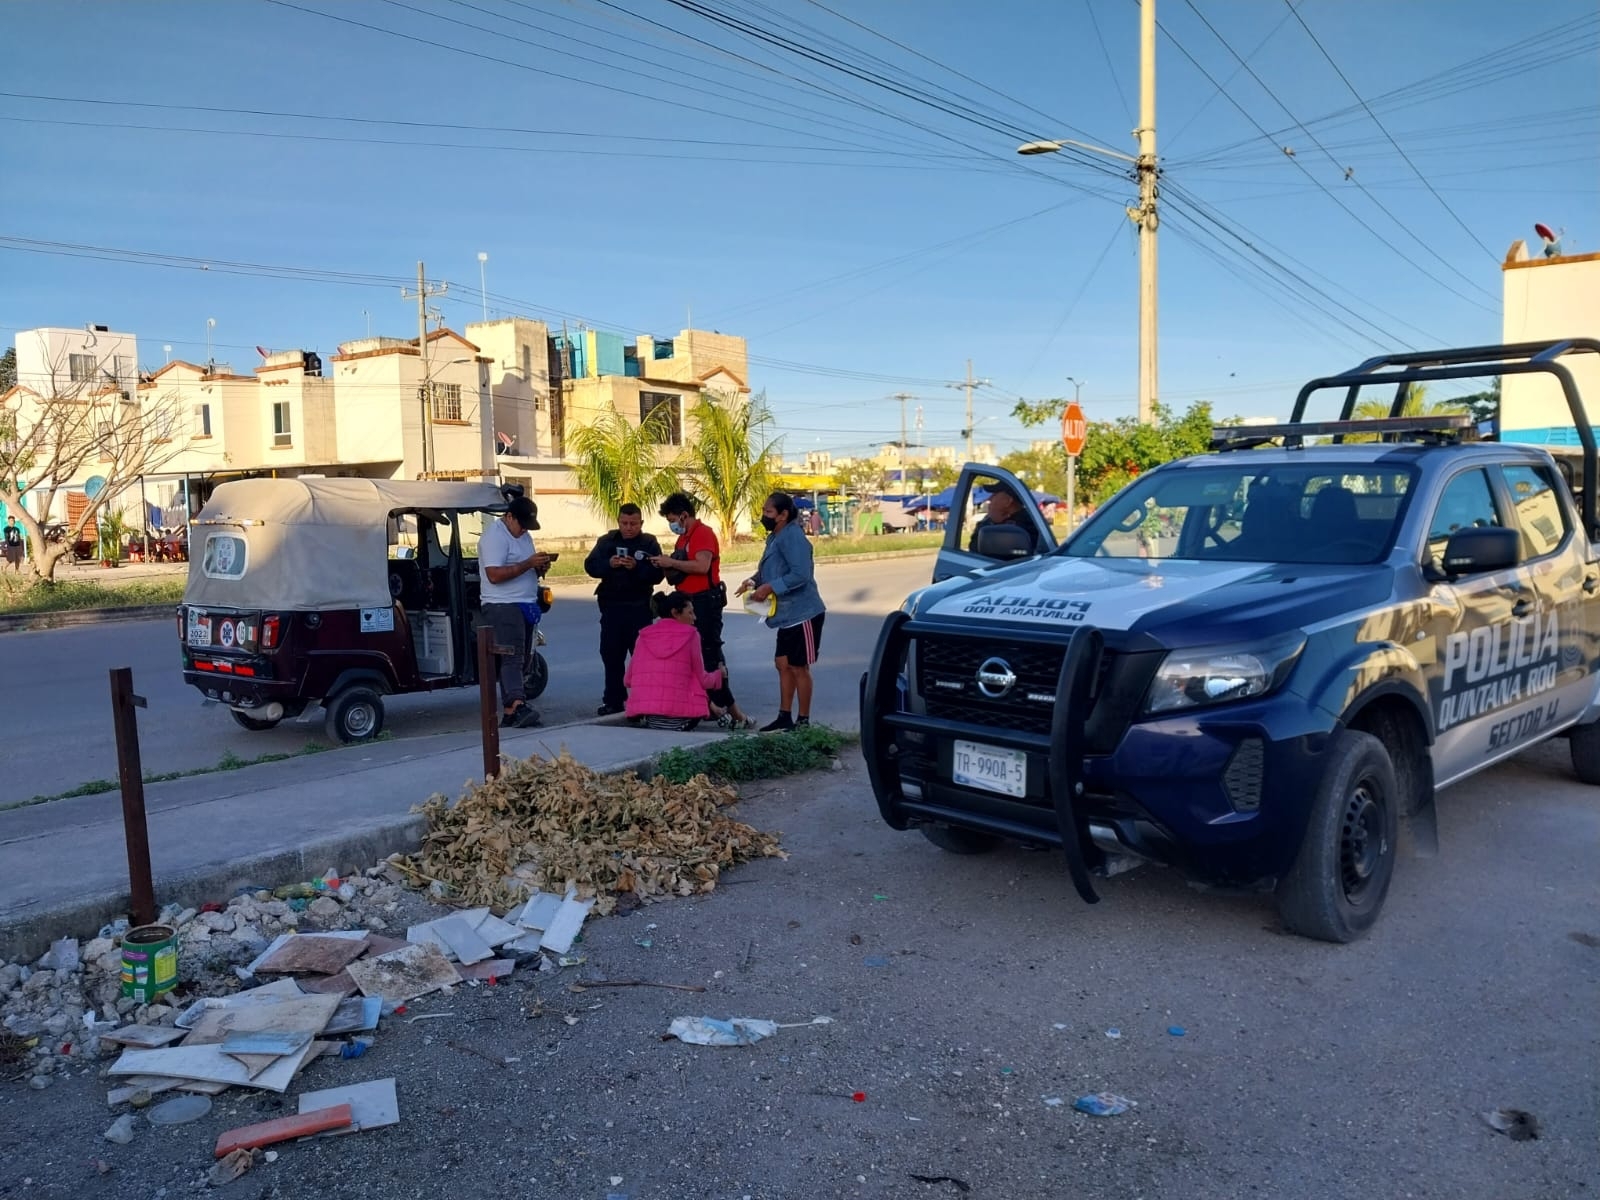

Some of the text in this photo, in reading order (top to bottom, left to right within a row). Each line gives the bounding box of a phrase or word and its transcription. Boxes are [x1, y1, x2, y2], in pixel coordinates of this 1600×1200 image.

[1064, 419, 1084, 440] ALTO
[1438, 661, 1558, 731] QUINTANA ROO
[1485, 706, 1543, 754] SECTOR
[956, 752, 1023, 783] TR-990A-5
